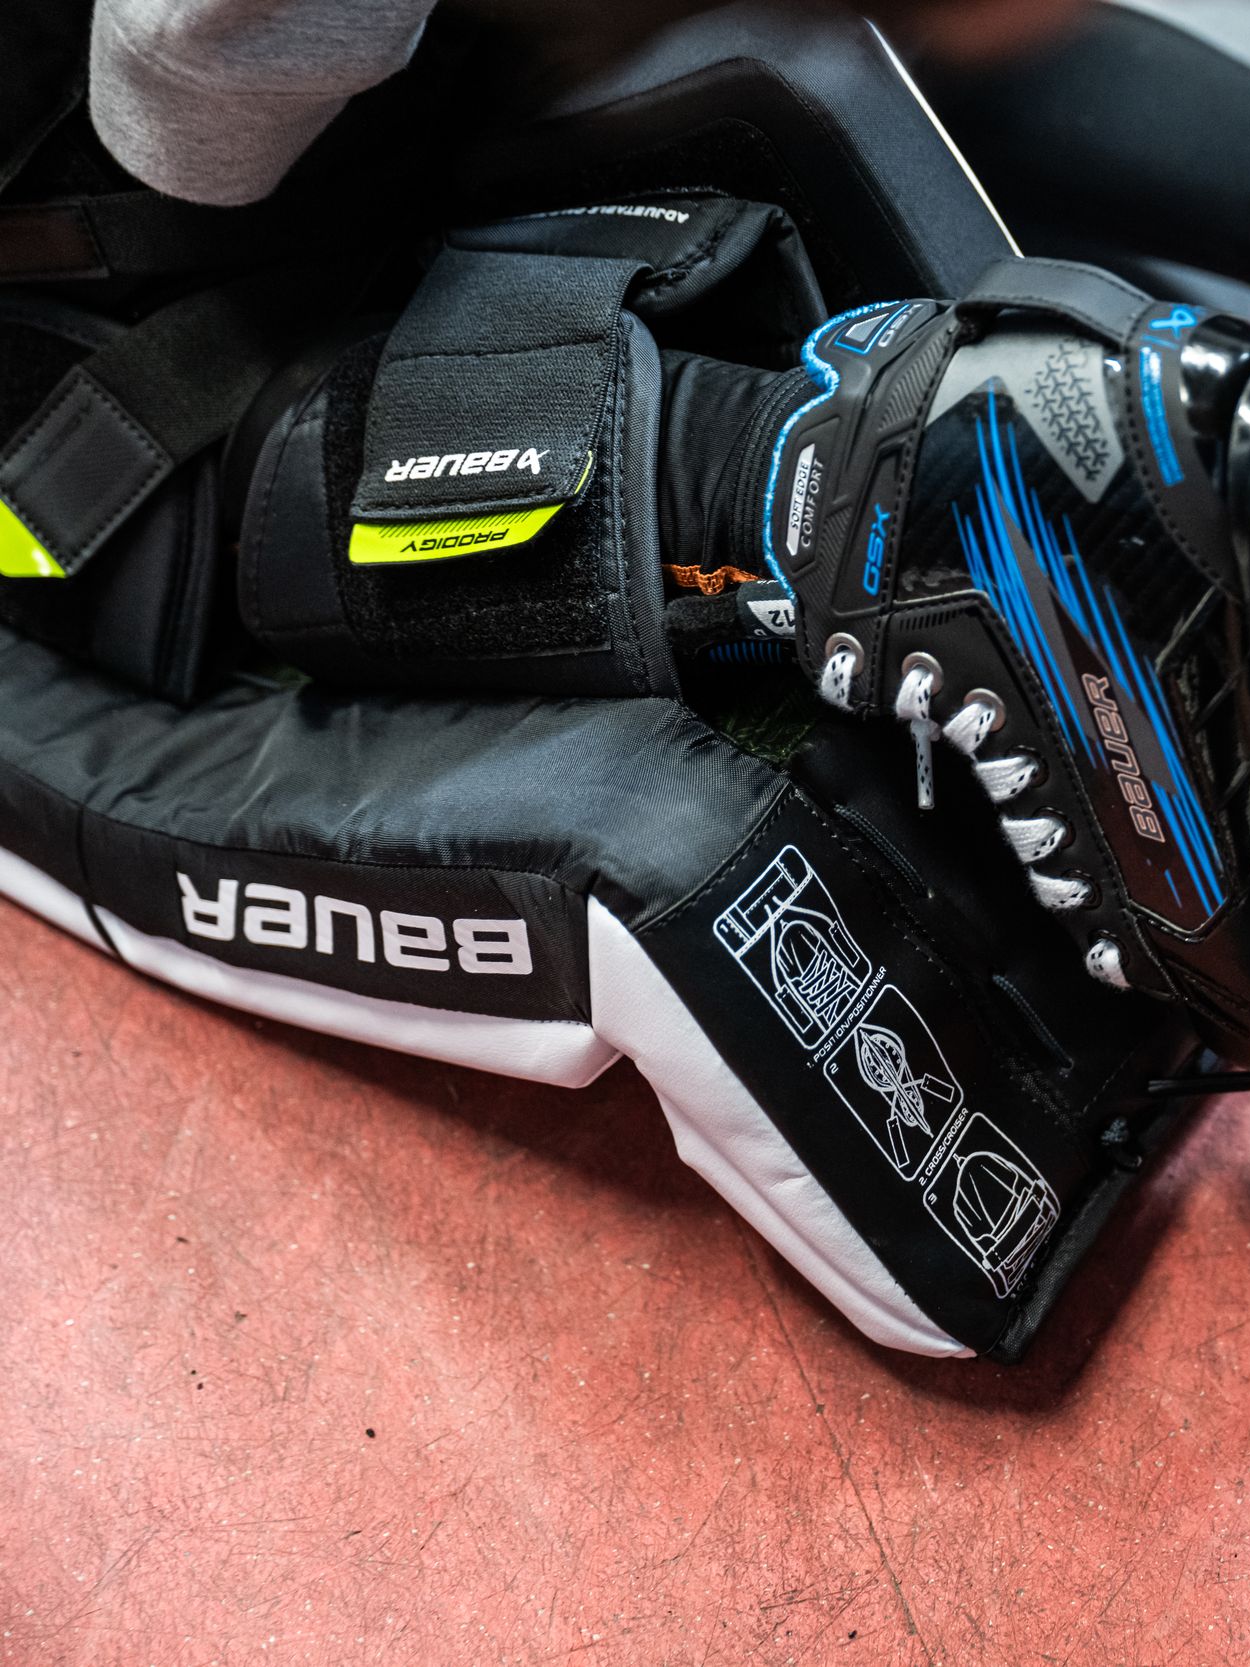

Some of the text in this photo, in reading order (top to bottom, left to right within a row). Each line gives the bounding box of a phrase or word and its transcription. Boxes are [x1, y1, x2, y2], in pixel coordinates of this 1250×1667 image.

[384, 449, 520, 482] BAUER
[791, 461, 810, 530] SOFT EDGE
[801, 457, 824, 548] COMFORT
[400, 528, 510, 553] PRODIGY
[863, 503, 891, 596] GSX
[1081, 673, 1166, 843] BAUER
[176, 871, 534, 976] BAUER
[813, 966, 887, 1063] POSITION/POSITIONNER
[829, 1062, 840, 1075] 2
[925, 1107, 969, 1177] CROSS/CROISER
[927, 1192, 938, 1205] 3
